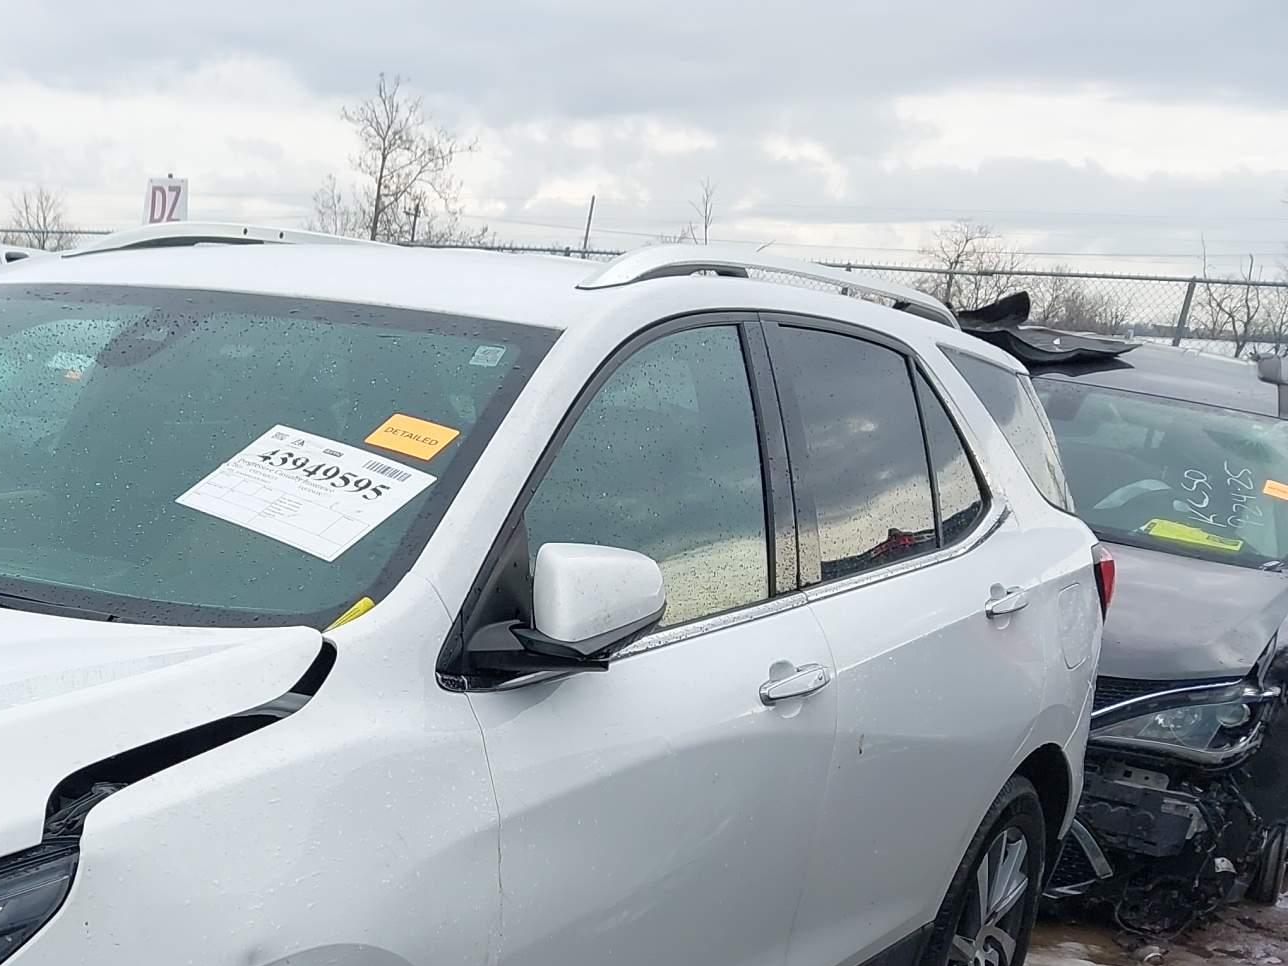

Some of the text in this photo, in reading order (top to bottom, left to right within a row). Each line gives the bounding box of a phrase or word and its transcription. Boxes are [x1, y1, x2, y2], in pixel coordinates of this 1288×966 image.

[149, 185, 181, 224] DZ
[384, 427, 438, 446] DETAILED
[258, 449, 391, 500] 43949595
